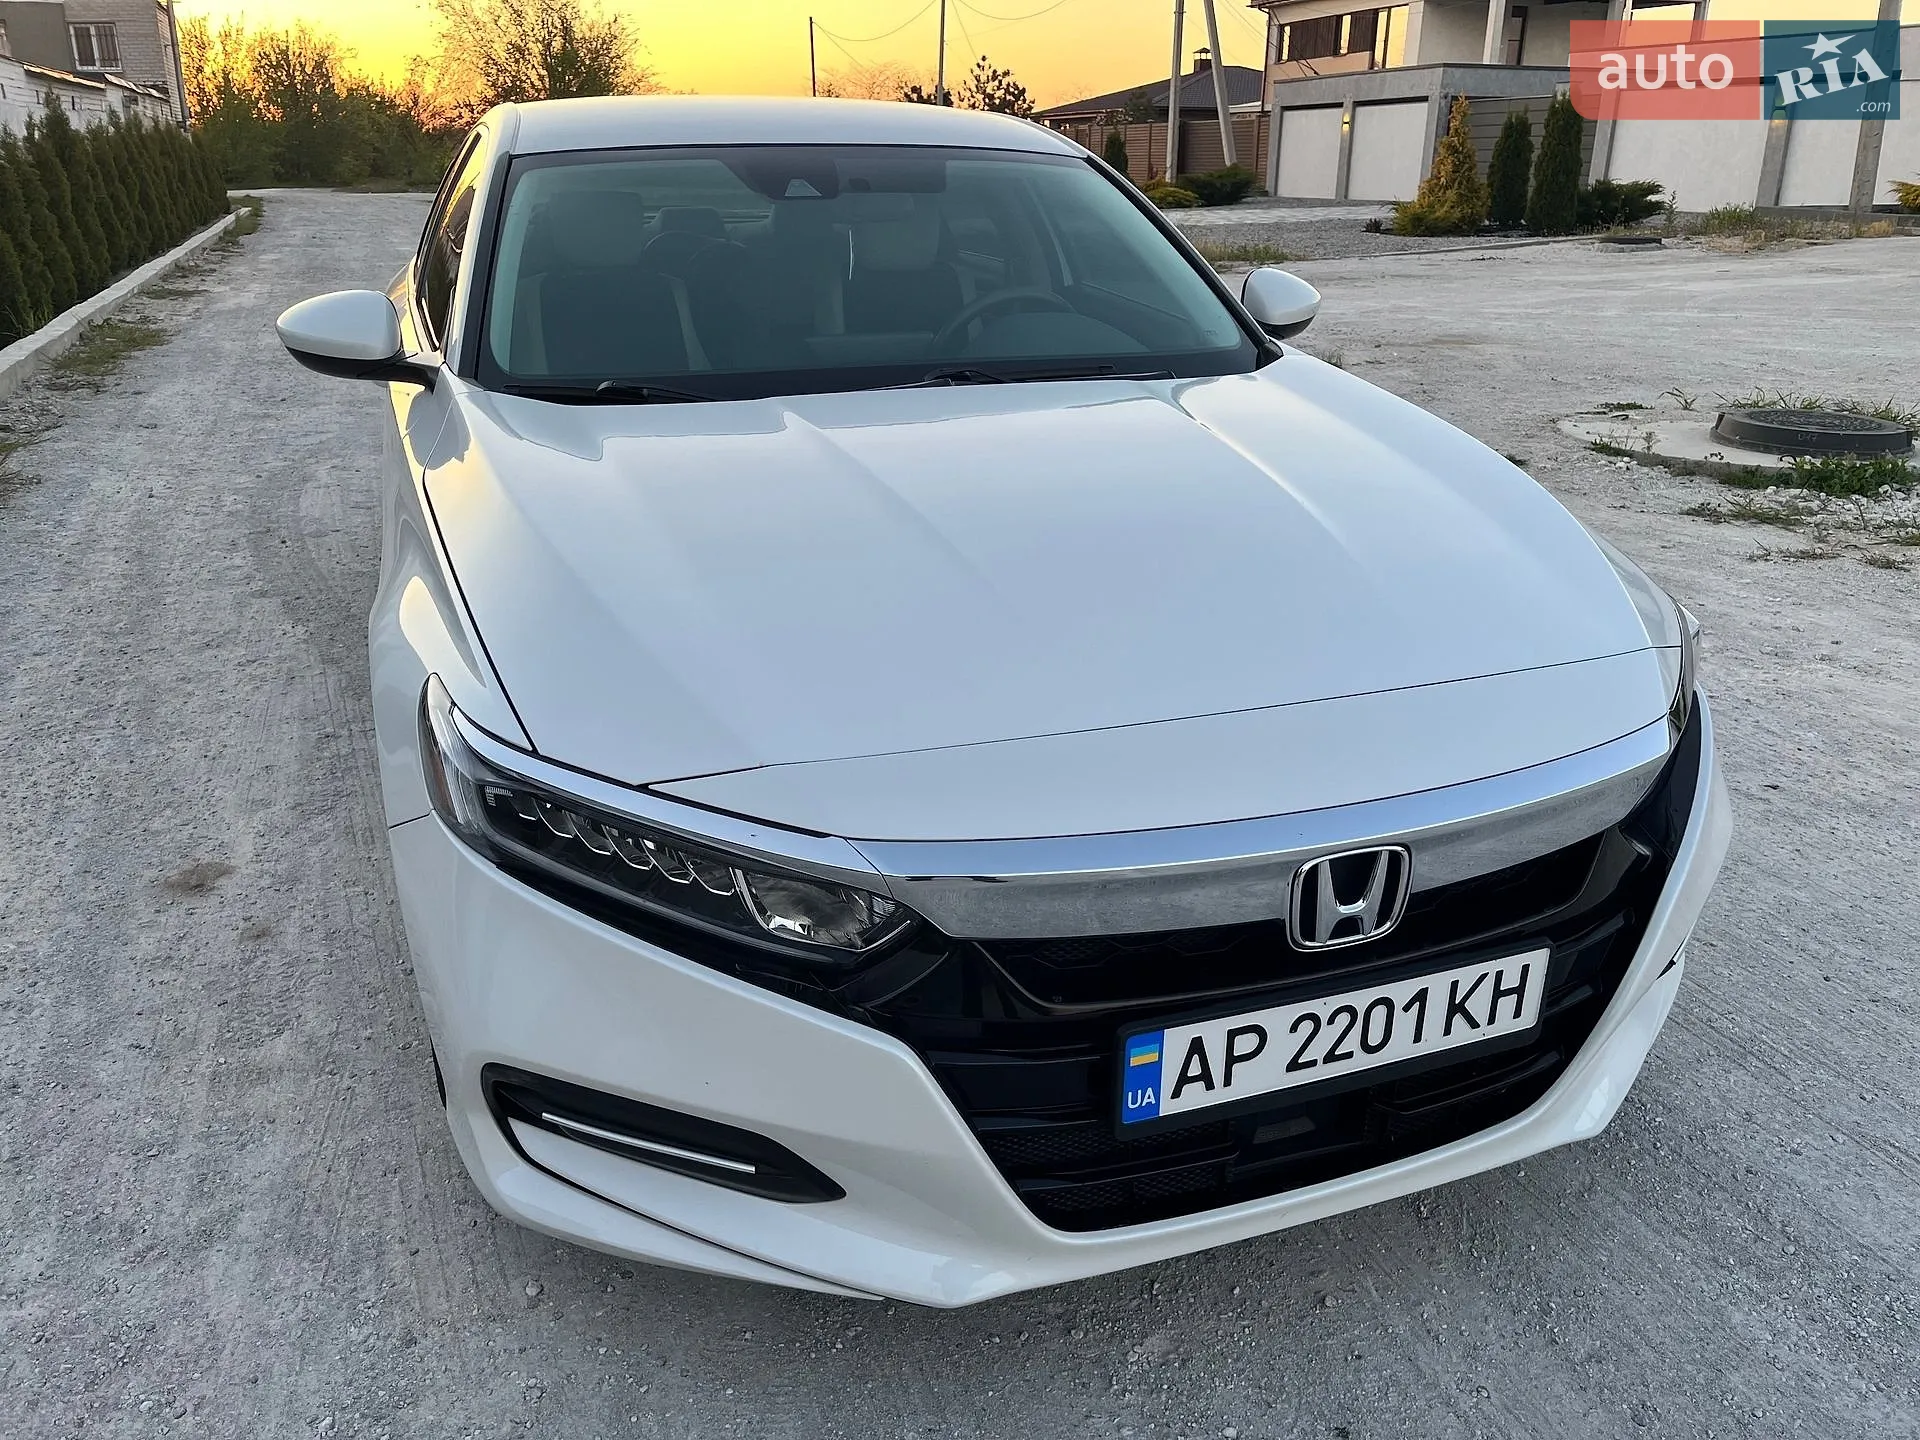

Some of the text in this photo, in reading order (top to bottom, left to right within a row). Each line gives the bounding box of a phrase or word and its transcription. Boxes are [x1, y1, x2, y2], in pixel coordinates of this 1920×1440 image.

[1169, 962, 1531, 1100] AP 2201 KH
[1127, 1086, 1156, 1109] UA
